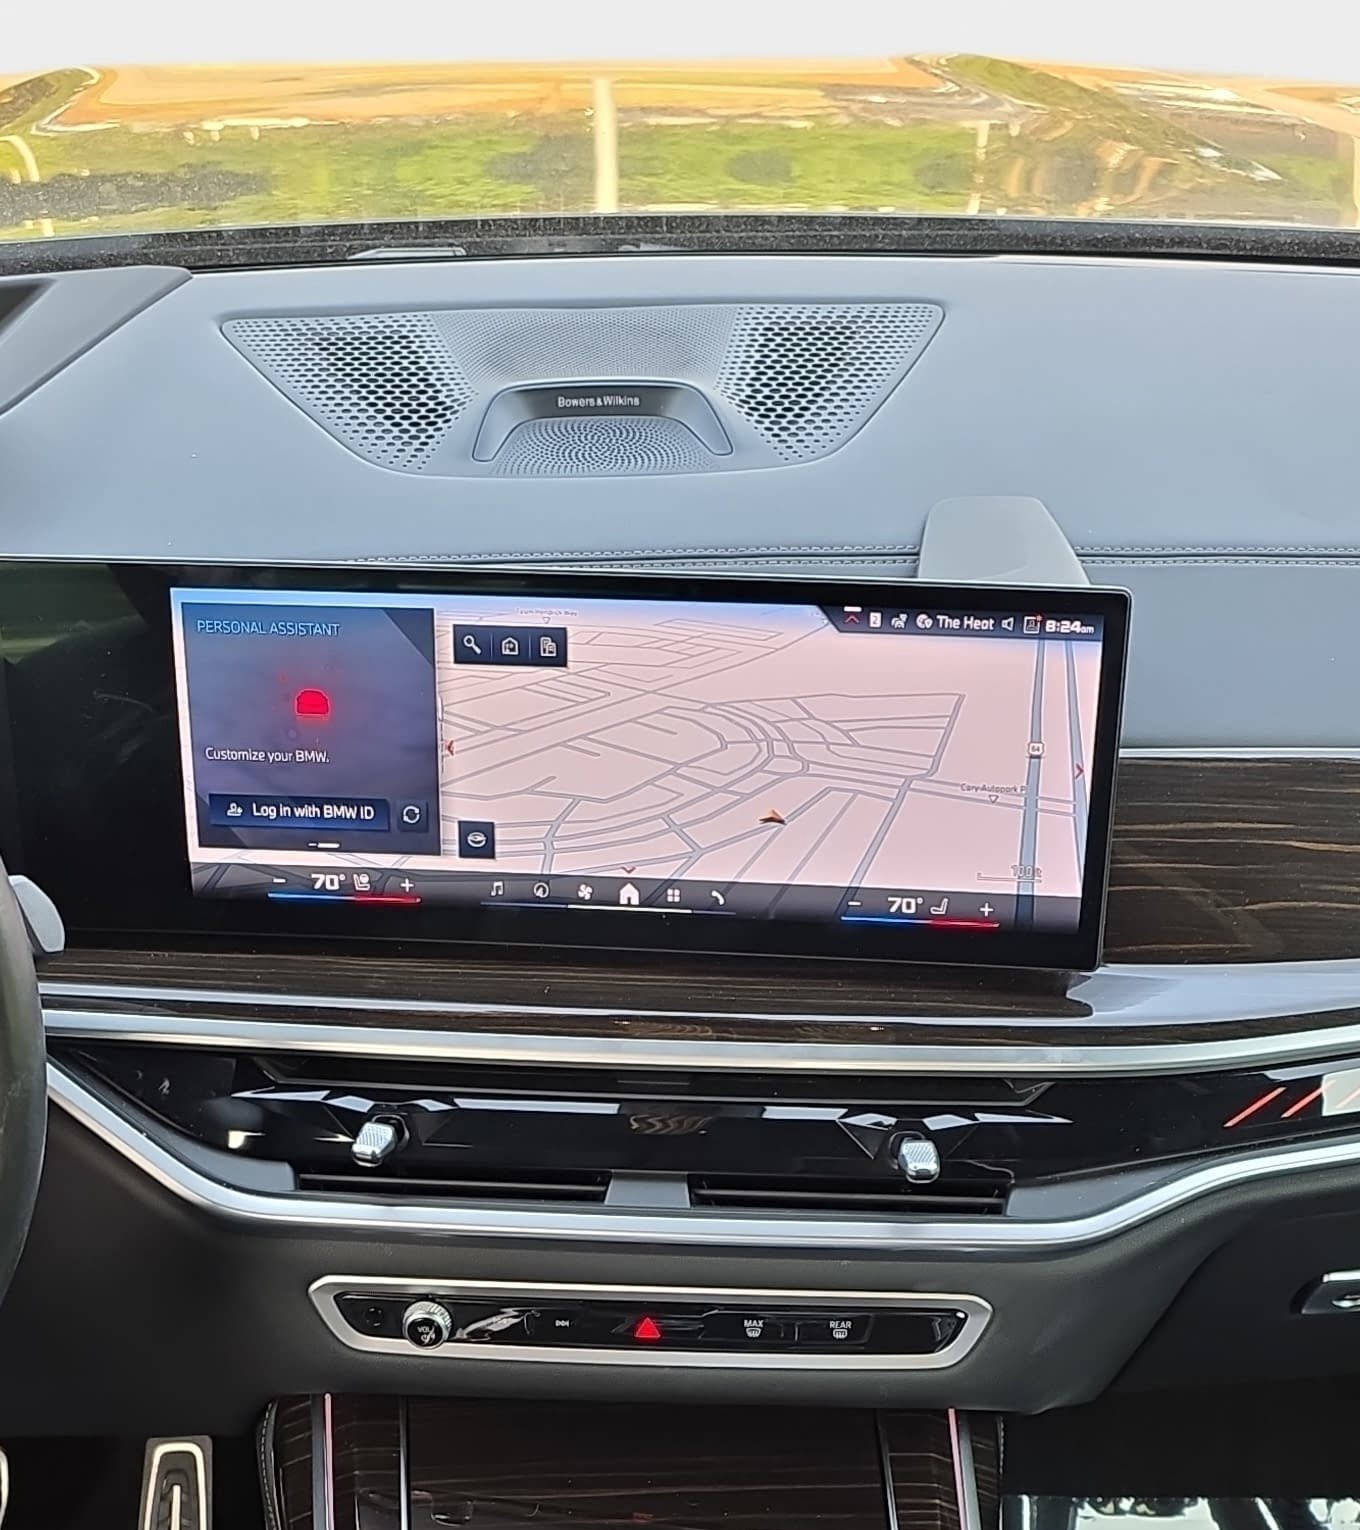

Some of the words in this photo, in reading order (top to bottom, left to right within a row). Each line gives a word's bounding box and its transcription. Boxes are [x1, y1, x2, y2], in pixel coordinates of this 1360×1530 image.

[197, 619, 267, 635] PERSONAL
[270, 621, 340, 637] ASSISTANT
[937, 615, 961, 630] The
[963, 616, 995, 631] Heat
[205, 747, 266, 762] Customize
[267, 751, 294, 764] your
[295, 749, 330, 763] BMW.
[252, 802, 277, 820] Log
[280, 803, 291, 818] in
[293, 803, 321, 819] with
[323, 804, 357, 820] BMW
[360, 805, 375, 820] ID
[311, 872, 346, 890] 70°
[888, 896, 924, 914] 70°
[743, 1319, 764, 1329] MAX
[829, 1320, 852, 1330] REAR
